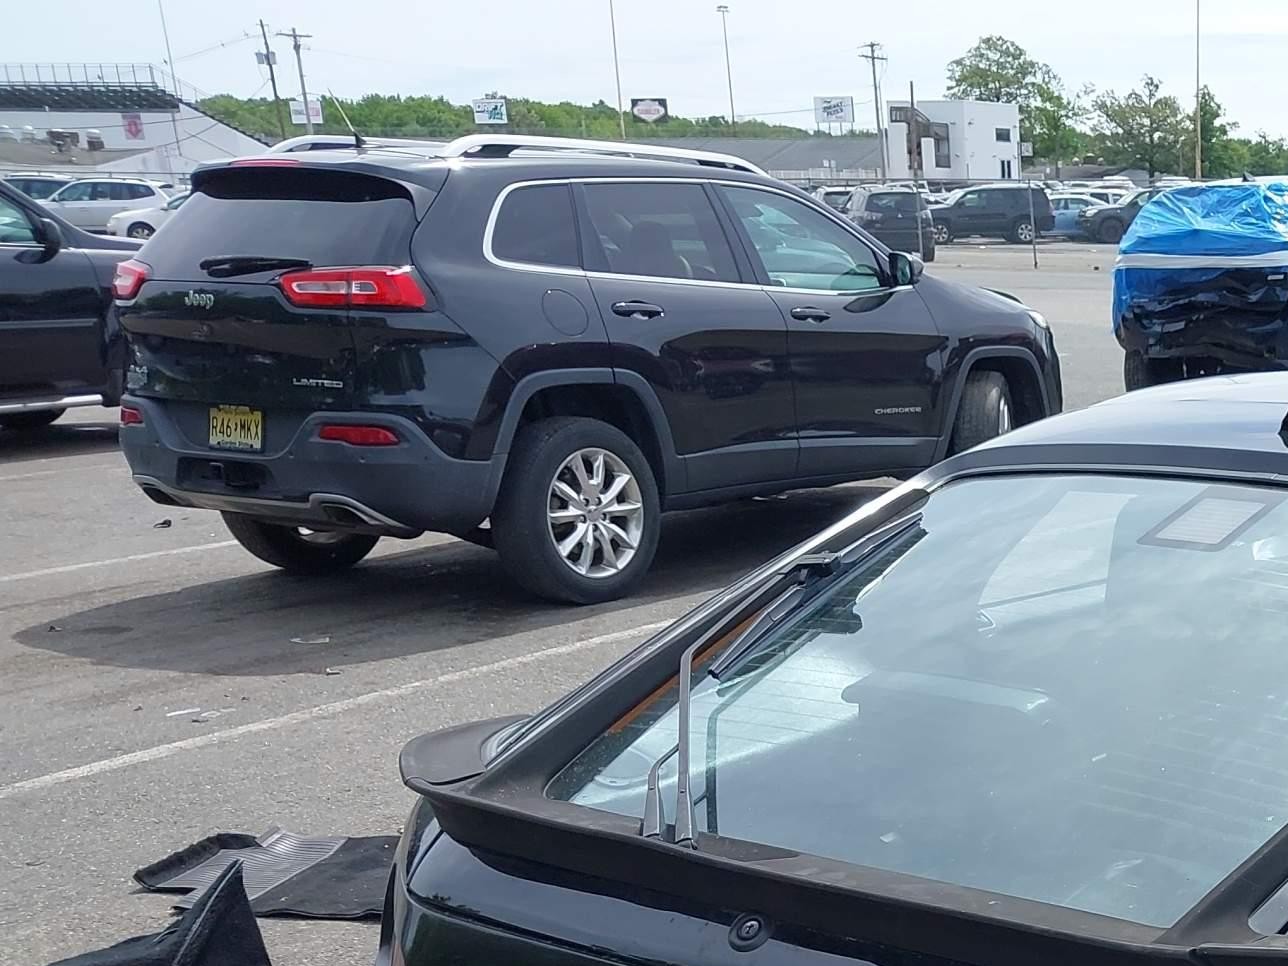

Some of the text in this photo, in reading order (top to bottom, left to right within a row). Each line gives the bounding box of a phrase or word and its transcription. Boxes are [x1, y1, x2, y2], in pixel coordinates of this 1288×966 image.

[184, 290, 214, 309] Jeep
[292, 378, 344, 388] LIMITED
[874, 406, 922, 415] CHEROKEE
[211, 416, 260, 440] R46 MKX
